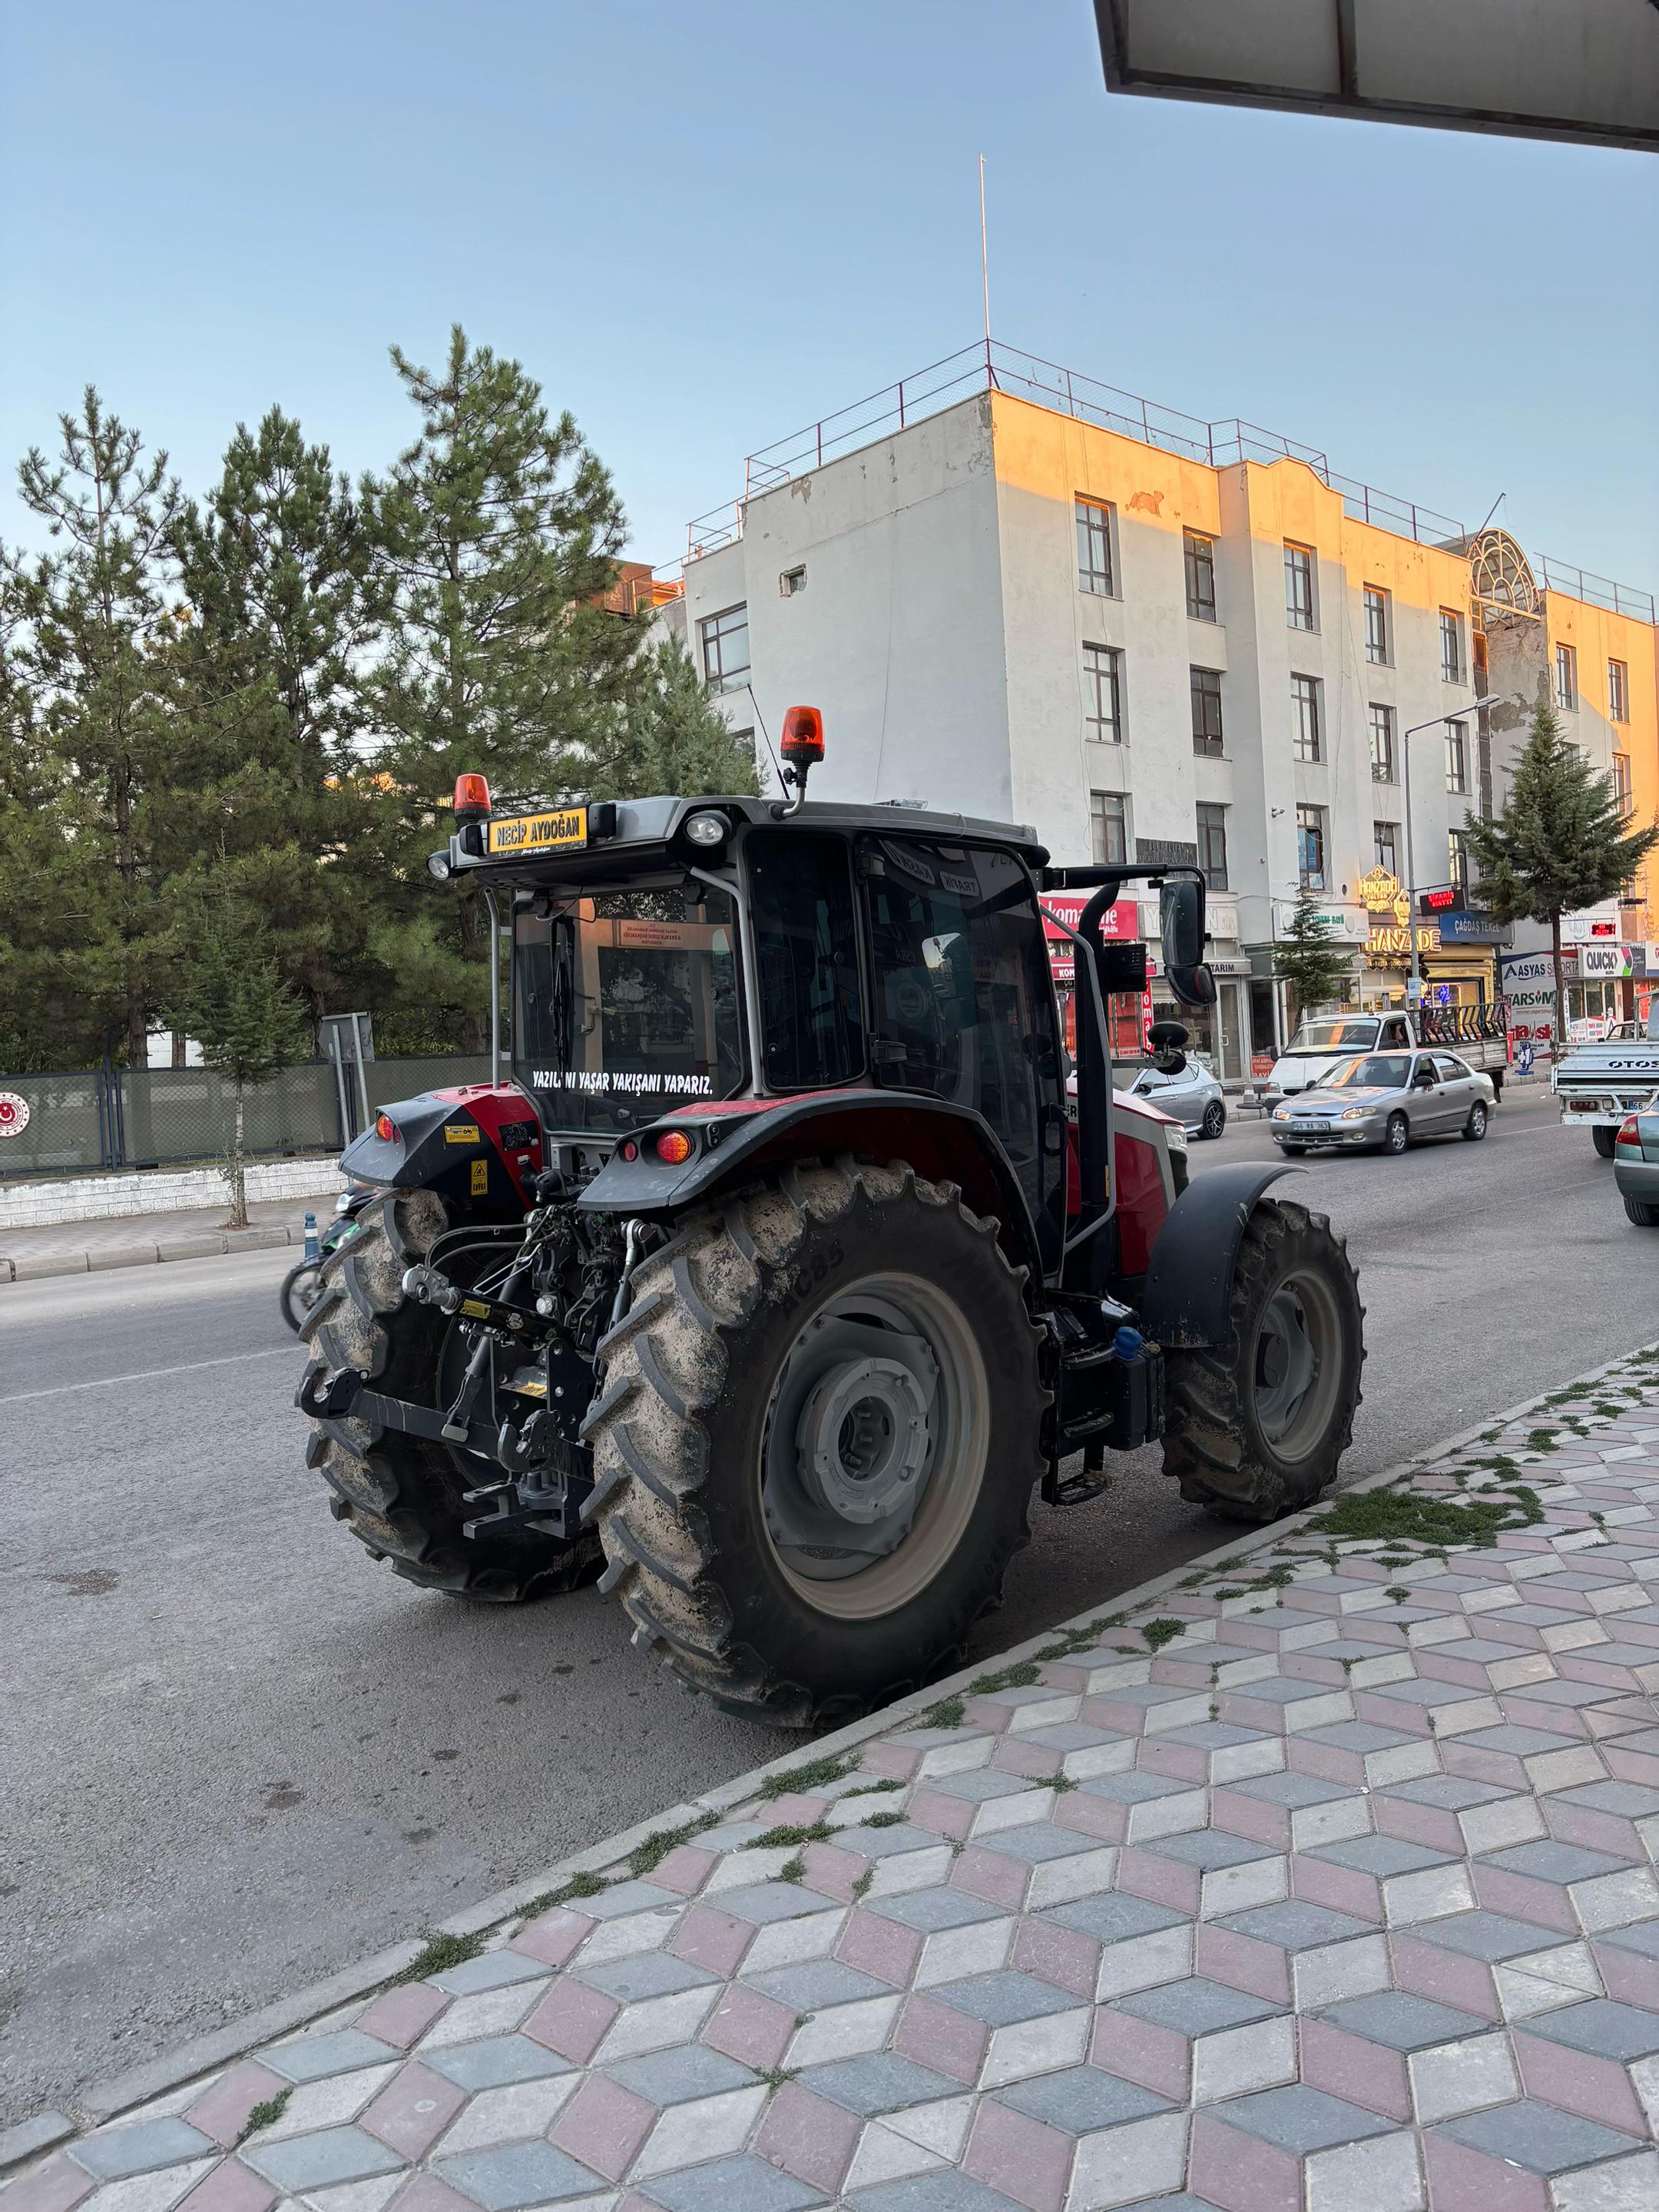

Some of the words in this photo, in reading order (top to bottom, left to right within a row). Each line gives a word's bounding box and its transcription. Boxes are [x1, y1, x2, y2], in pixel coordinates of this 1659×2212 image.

[498, 820, 527, 846] NECİP
[530, 813, 579, 842] AYDOĞAN
[1455, 918, 1480, 935] ÇAĞDAŞ
[1518, 963, 1545, 977] ASYAS
[1587, 952, 1614, 970] QUICK
[579, 1072, 609, 1094] YAŞAR
[613, 1073, 660, 1096] YAKIŞANI
[664, 1075, 713, 1094] YAPARIZ.
